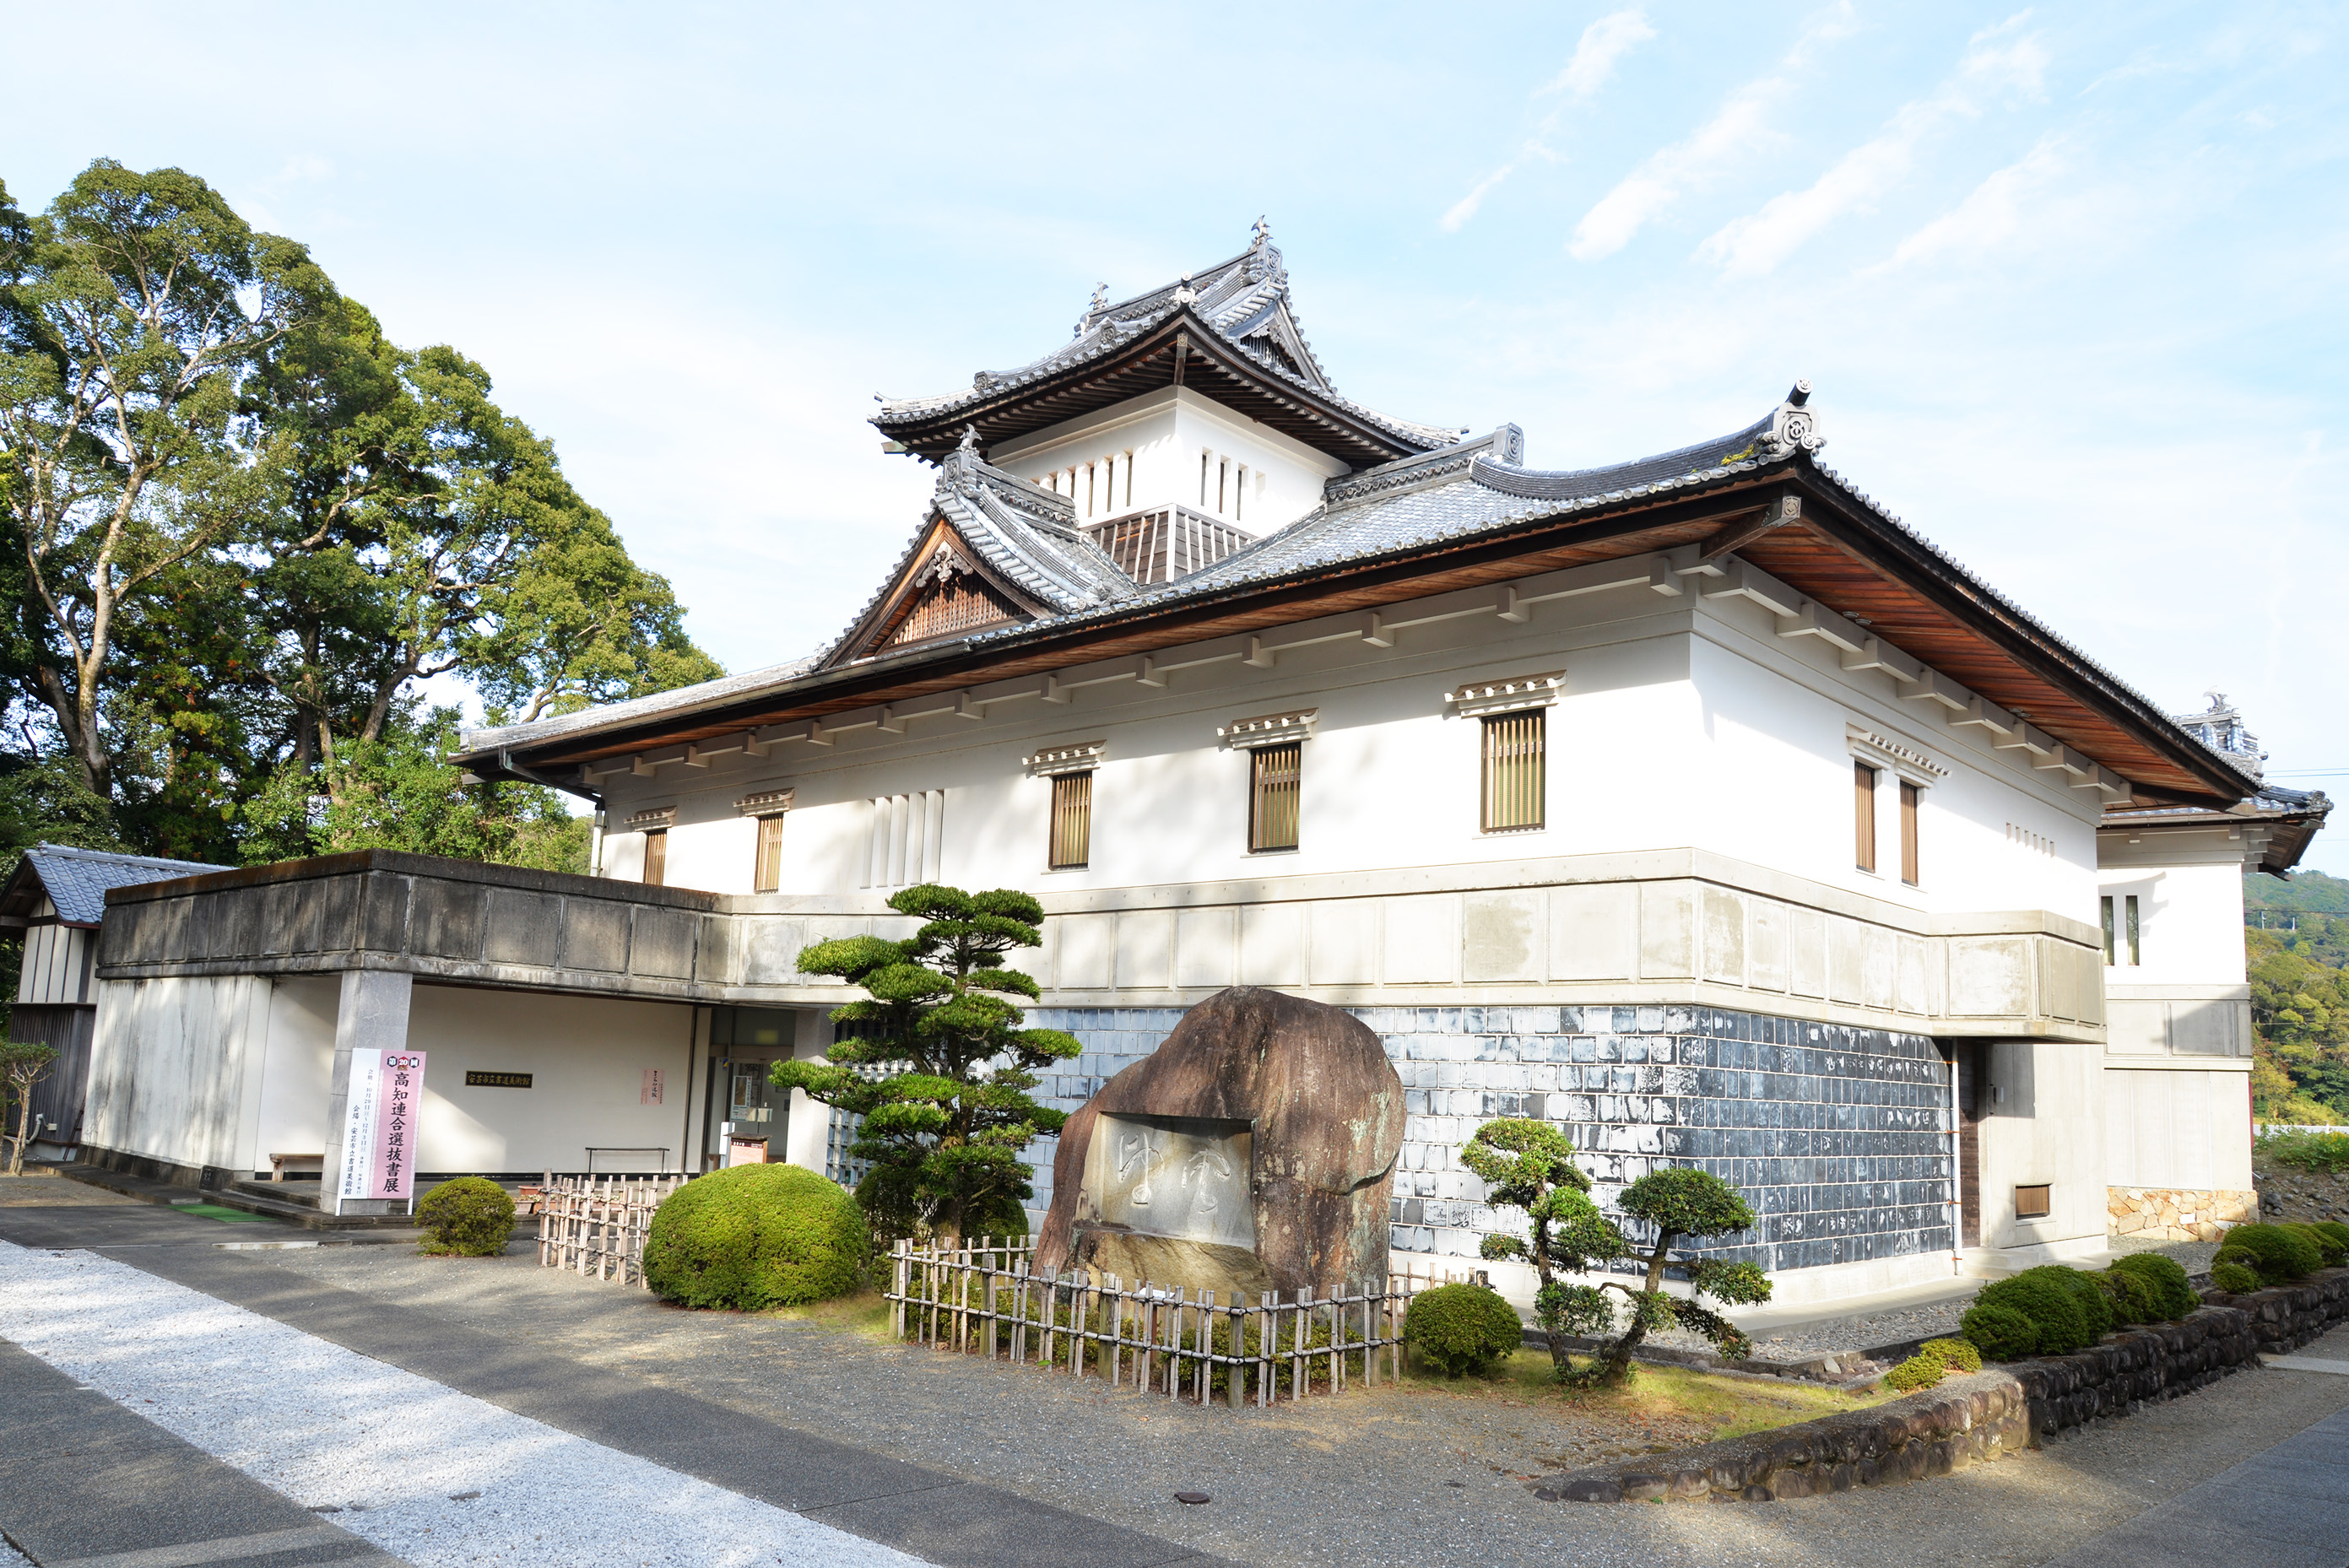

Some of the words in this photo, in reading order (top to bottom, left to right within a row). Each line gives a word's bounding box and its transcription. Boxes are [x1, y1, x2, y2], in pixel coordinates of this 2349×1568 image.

[468, 1073, 531, 1085] 安芸市立書道美術館
[382, 1072, 409, 1192] 高知連合選抜書展
